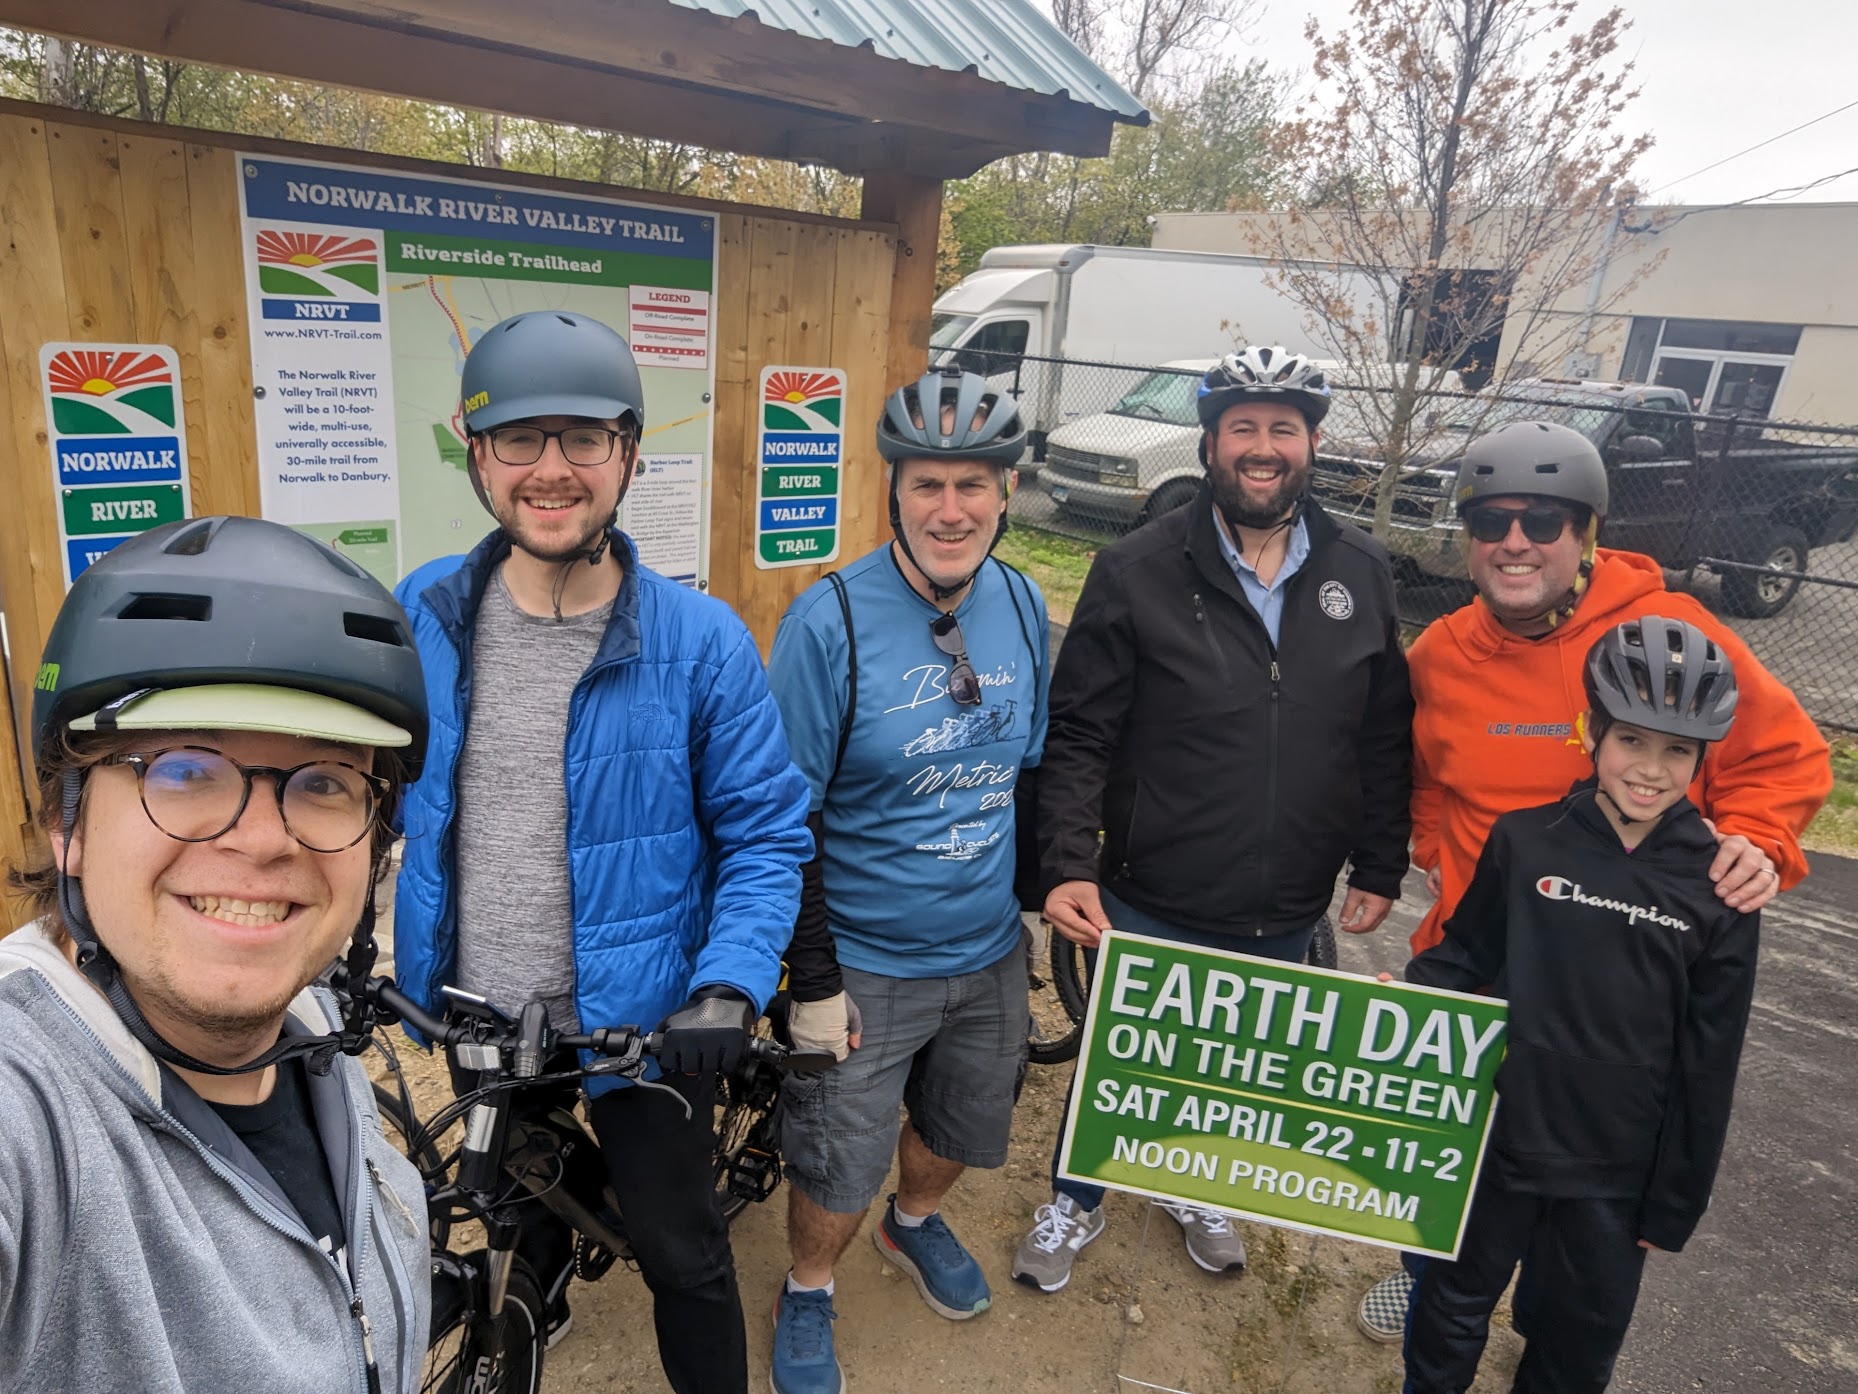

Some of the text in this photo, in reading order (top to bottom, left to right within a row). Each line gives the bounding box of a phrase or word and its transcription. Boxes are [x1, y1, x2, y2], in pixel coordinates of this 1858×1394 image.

[286, 181, 684, 243] NORWALK RIVER VALLEY TRAIL
[401, 244, 602, 273] Riverside Trailhead
[649, 292, 691, 303] LEGEND
[294, 303, 349, 319] NRVT
[264, 329, 382, 340] www.NRVT-Trail.com
[278, 370, 376, 380] The Norwalk River
[278, 387, 378, 399] Valley Trail (NRVT)
[284, 404, 304, 414] will
[306, 404, 320, 414] be
[333, 404, 374, 414] 10-foot-
[288, 421, 372, 432] wide, multi-use,
[275, 438, 387, 450] univerally accessible,
[765, 442, 837, 456] NORWALK
[61, 450, 176, 472] NORWALK
[286, 454, 378, 465] 30-mile trail from
[279, 471, 391, 483] Norwalk to Danbury.
[779, 475, 821, 489] RIVER
[90, 500, 158, 521] RIVER
[771, 506, 826, 521] VALLEY
[776, 538, 818, 553] TRAIL
[1487, 723, 1571, 736] LOS RUNNERS
[906, 760, 1015, 809] Metric
[1536, 875, 1691, 932] Champion
[1109, 953, 1507, 1079] EARTH DAY
[1106, 1023, 1477, 1126] ON THE GREEN
[1093, 1078, 1170, 1122] SAT
[1173, 1094, 1291, 1150] APRIL
[1300, 1121, 1355, 1162] 22
[1386, 1137, 1463, 1182] 11-2
[1112, 1135, 1420, 1223] NOON PROGRAM
